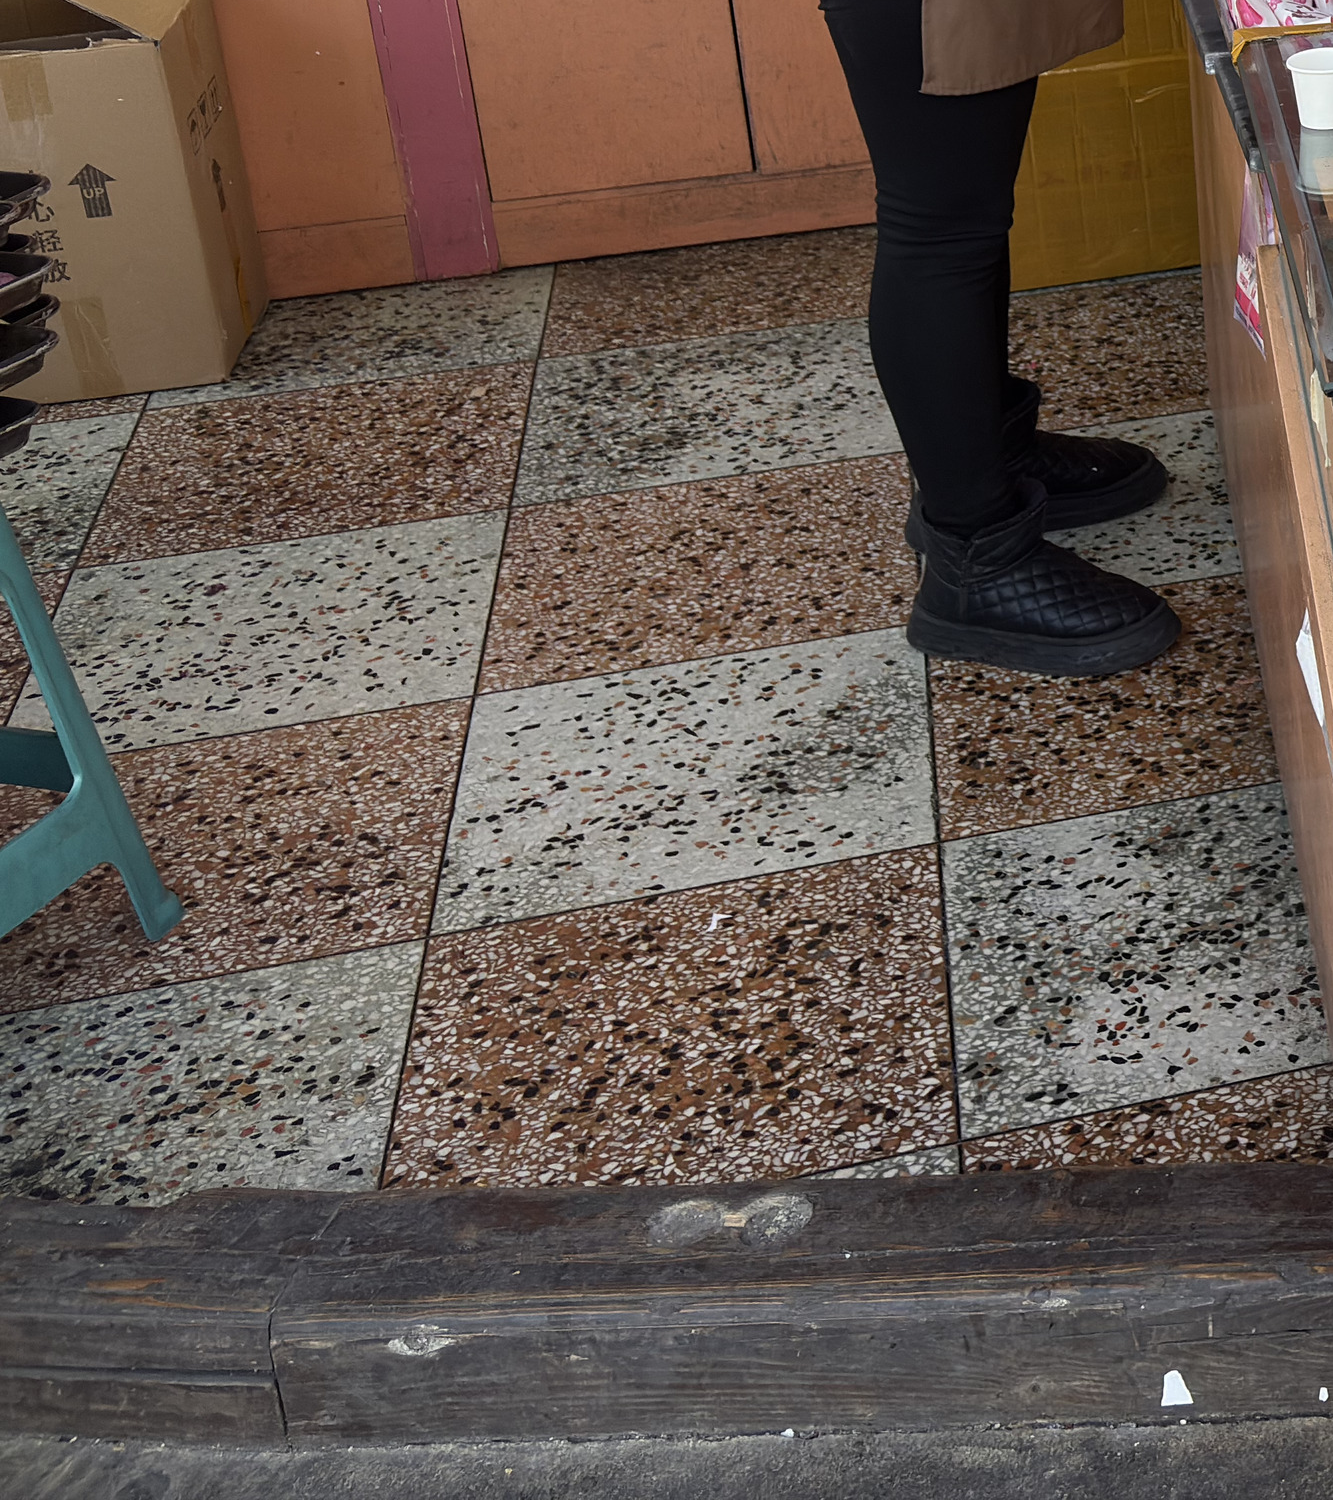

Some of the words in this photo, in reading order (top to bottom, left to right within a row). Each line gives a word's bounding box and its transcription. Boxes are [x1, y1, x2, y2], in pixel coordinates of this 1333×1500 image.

[82, 186, 105, 201] UP
[30, 200, 72, 284] 心轻放
